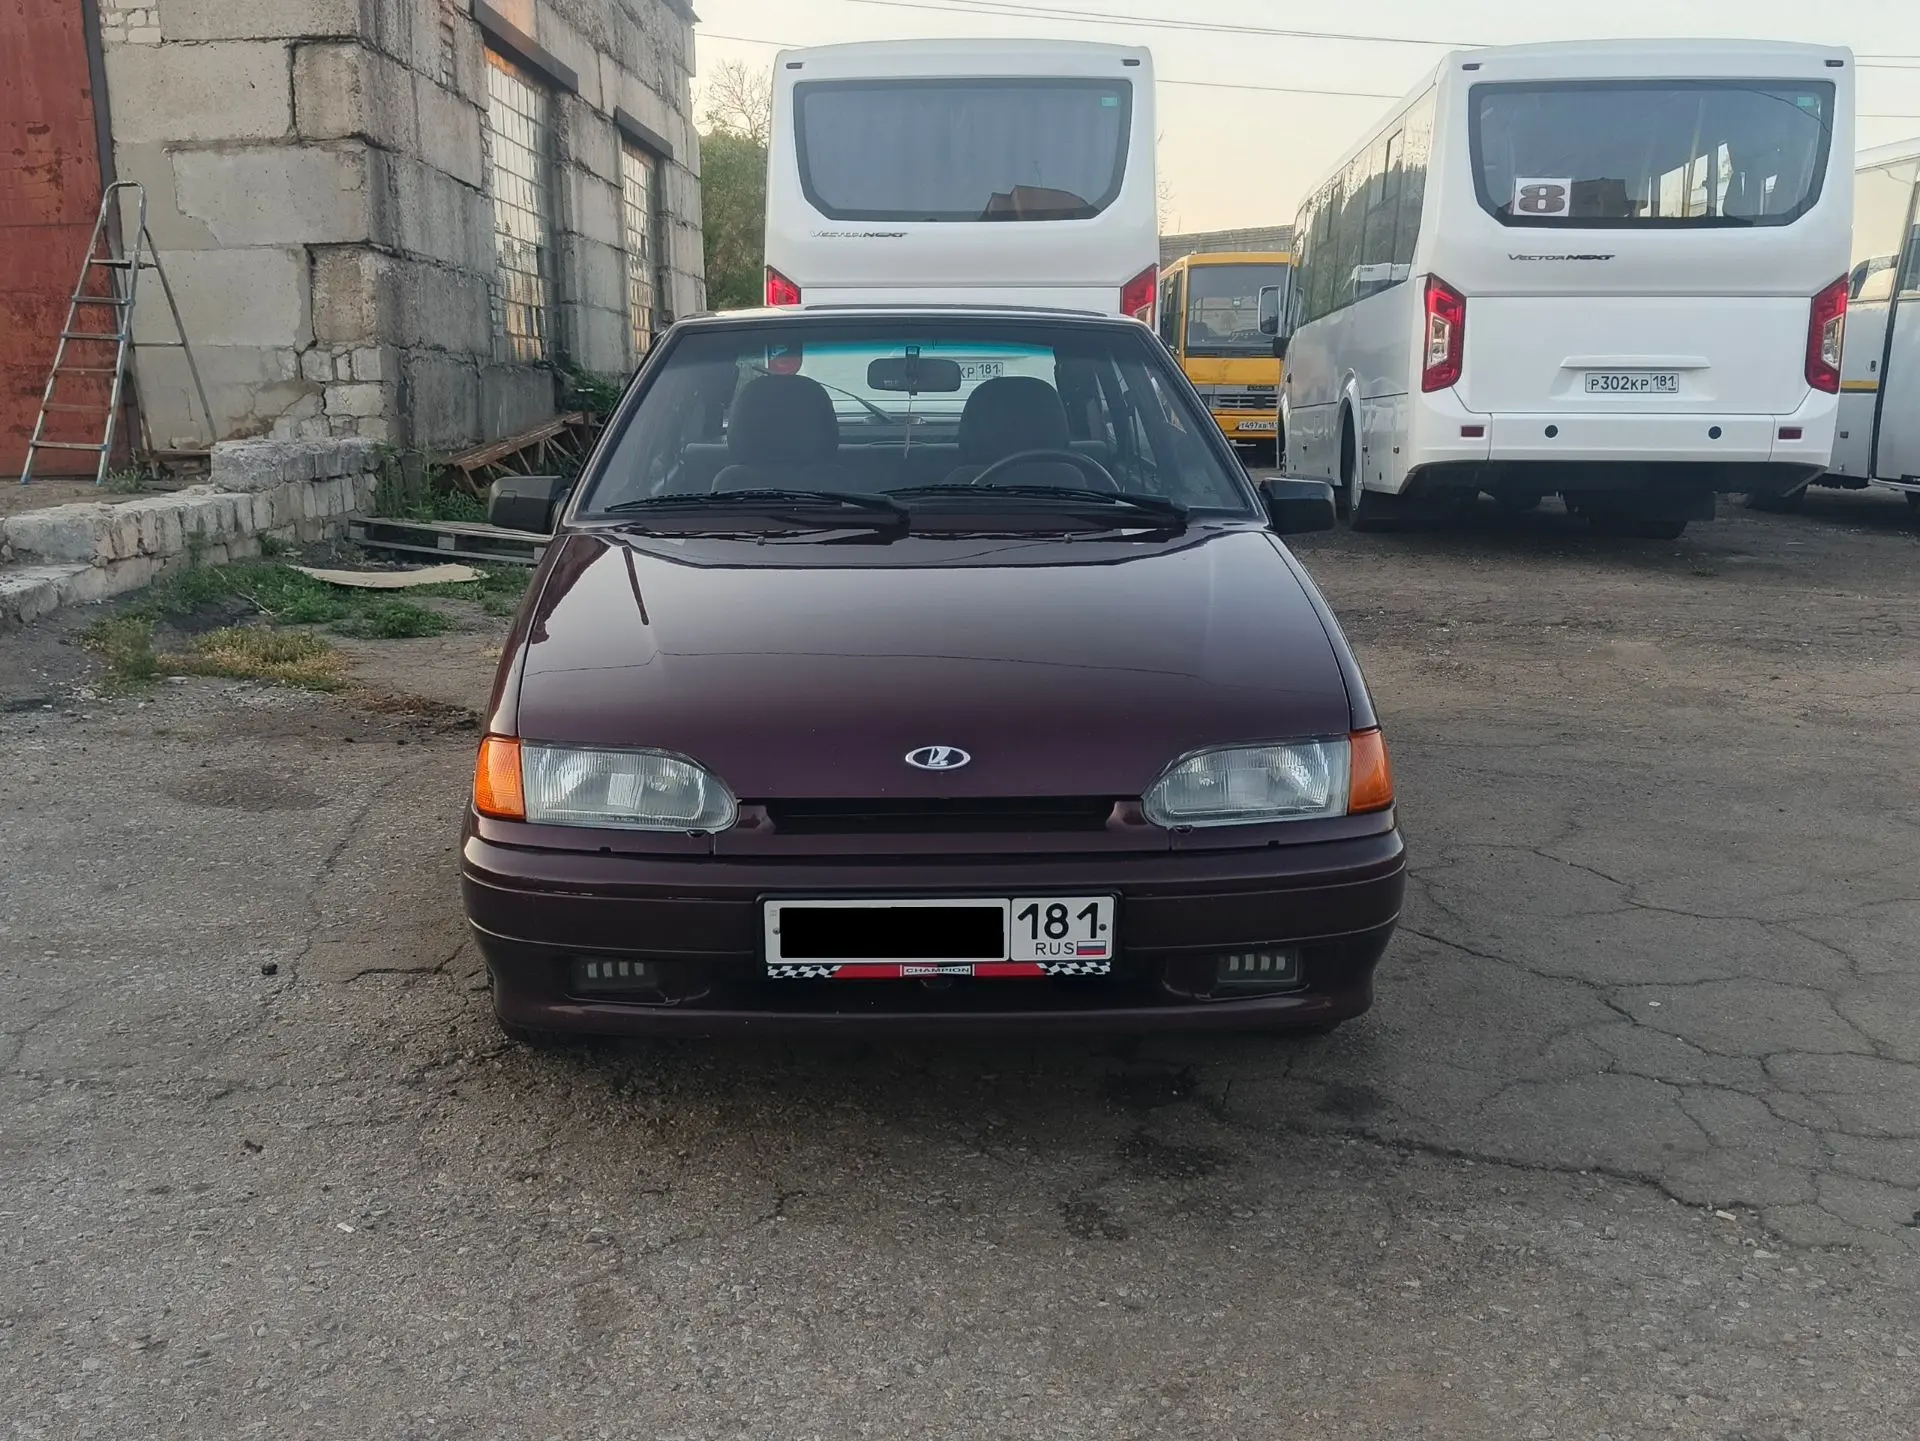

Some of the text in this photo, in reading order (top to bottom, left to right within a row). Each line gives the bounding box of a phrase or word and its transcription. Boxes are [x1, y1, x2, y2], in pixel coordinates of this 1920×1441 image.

[1518, 183, 1566, 213] 8
[1652, 375, 1675, 387] 181
[1017, 902, 1099, 940] 181
[1035, 942, 1075, 955] RUS
[905, 966, 970, 975] CHAMPION
